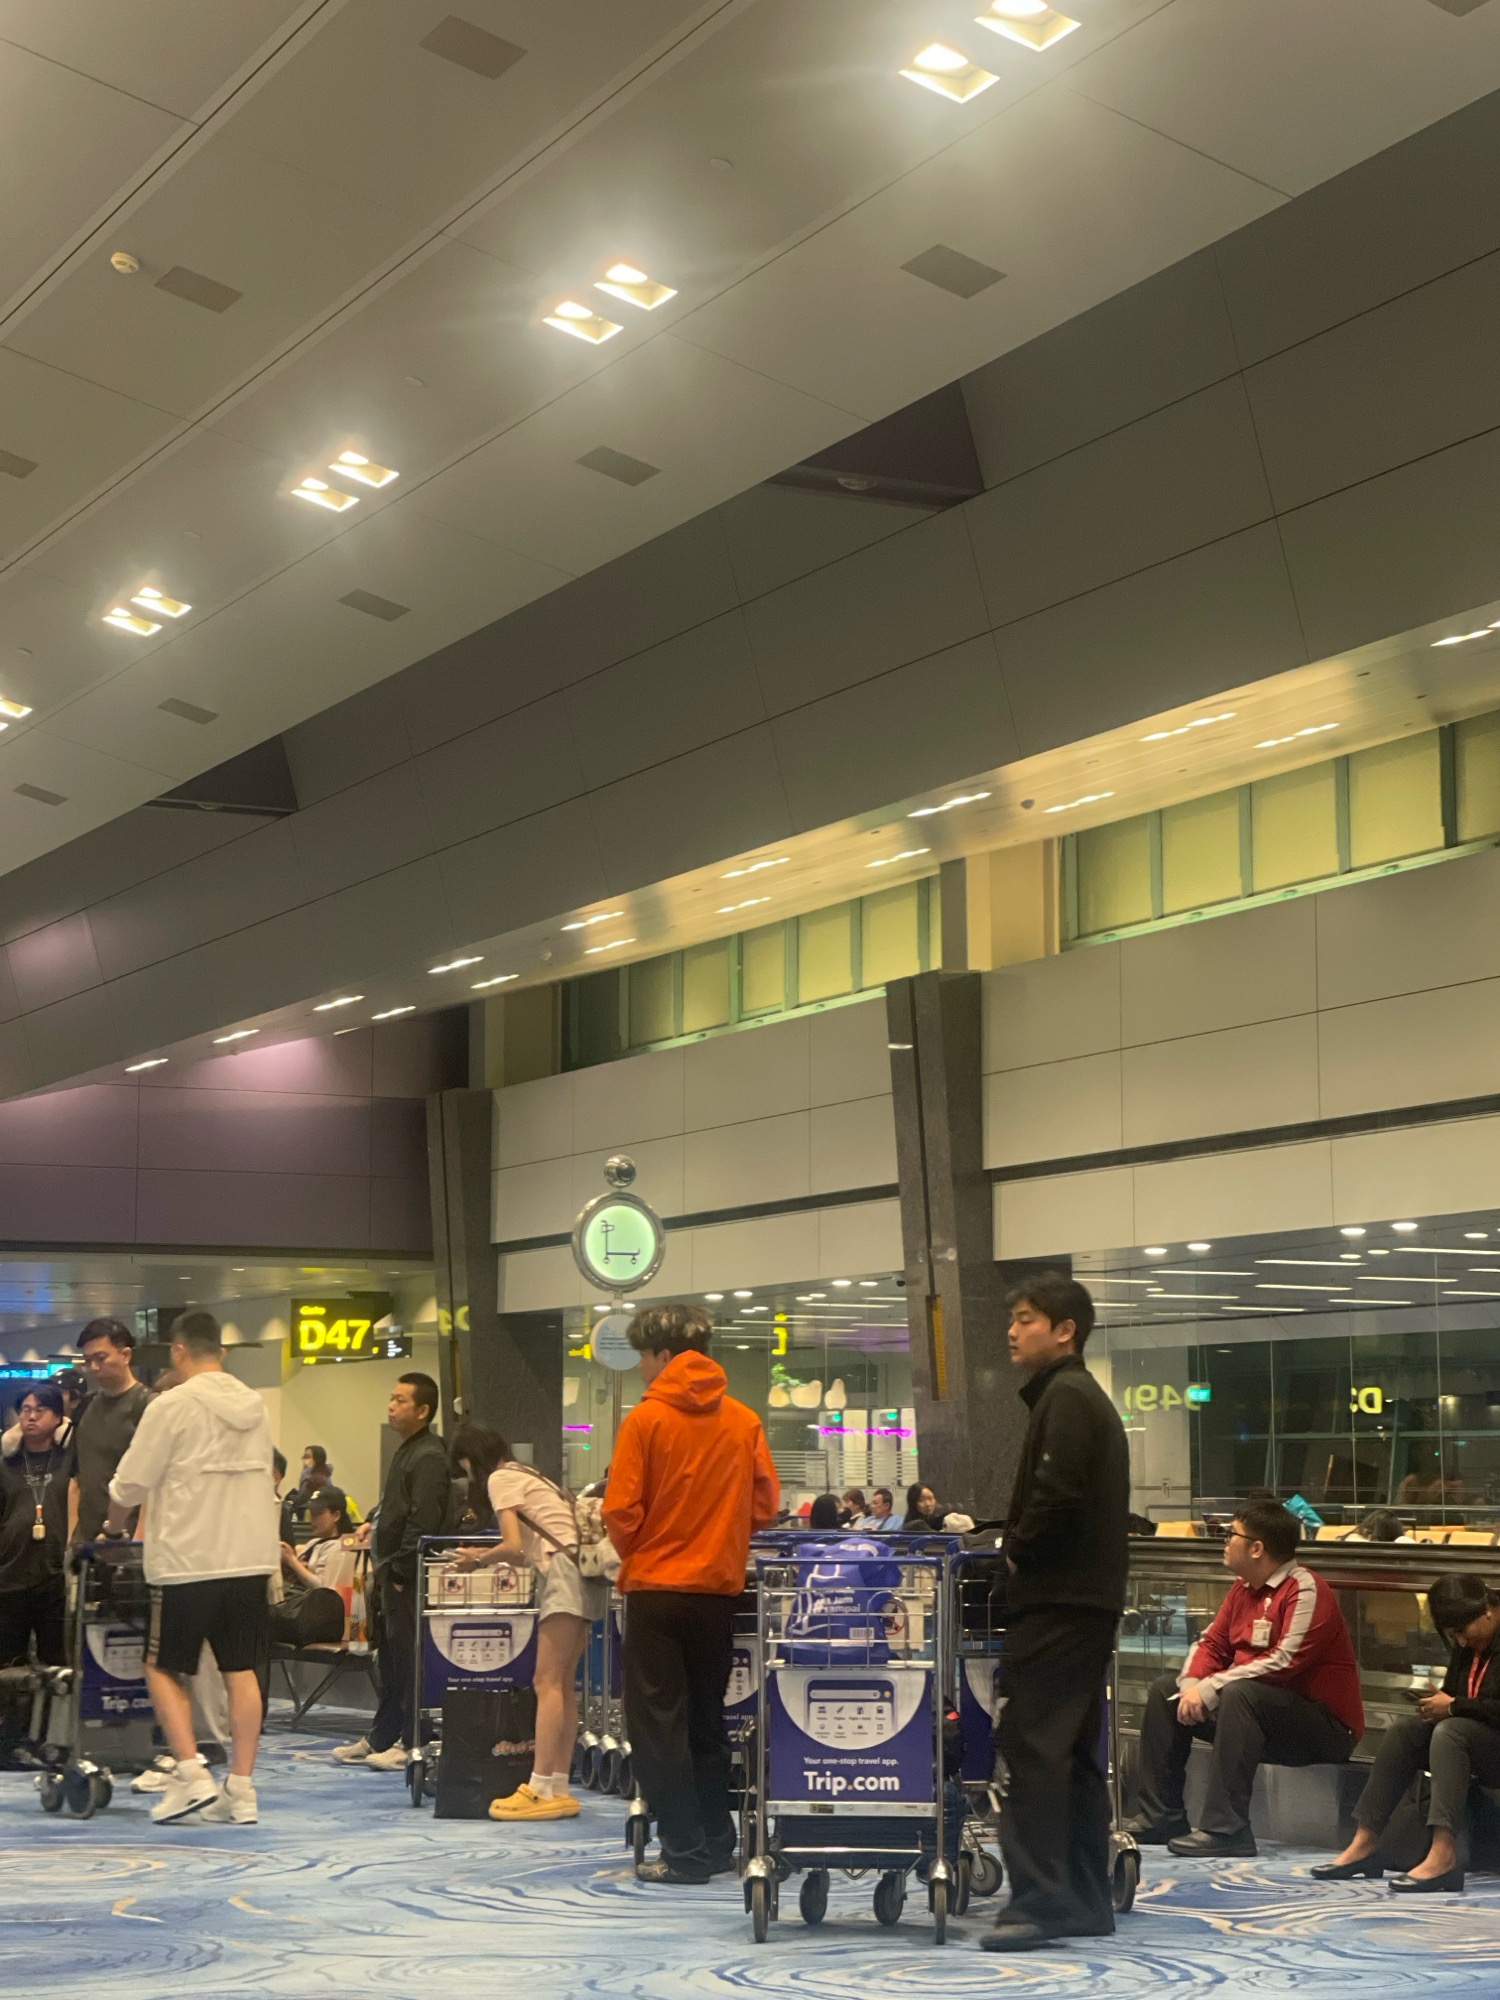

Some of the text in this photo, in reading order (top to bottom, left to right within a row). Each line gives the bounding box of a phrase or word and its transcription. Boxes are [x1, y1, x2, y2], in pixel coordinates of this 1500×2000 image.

[300, 1319, 371, 1350] D47
[804, 1757, 899, 1767] Your one-stop travel app.
[803, 1770, 900, 1796] Trip.com
